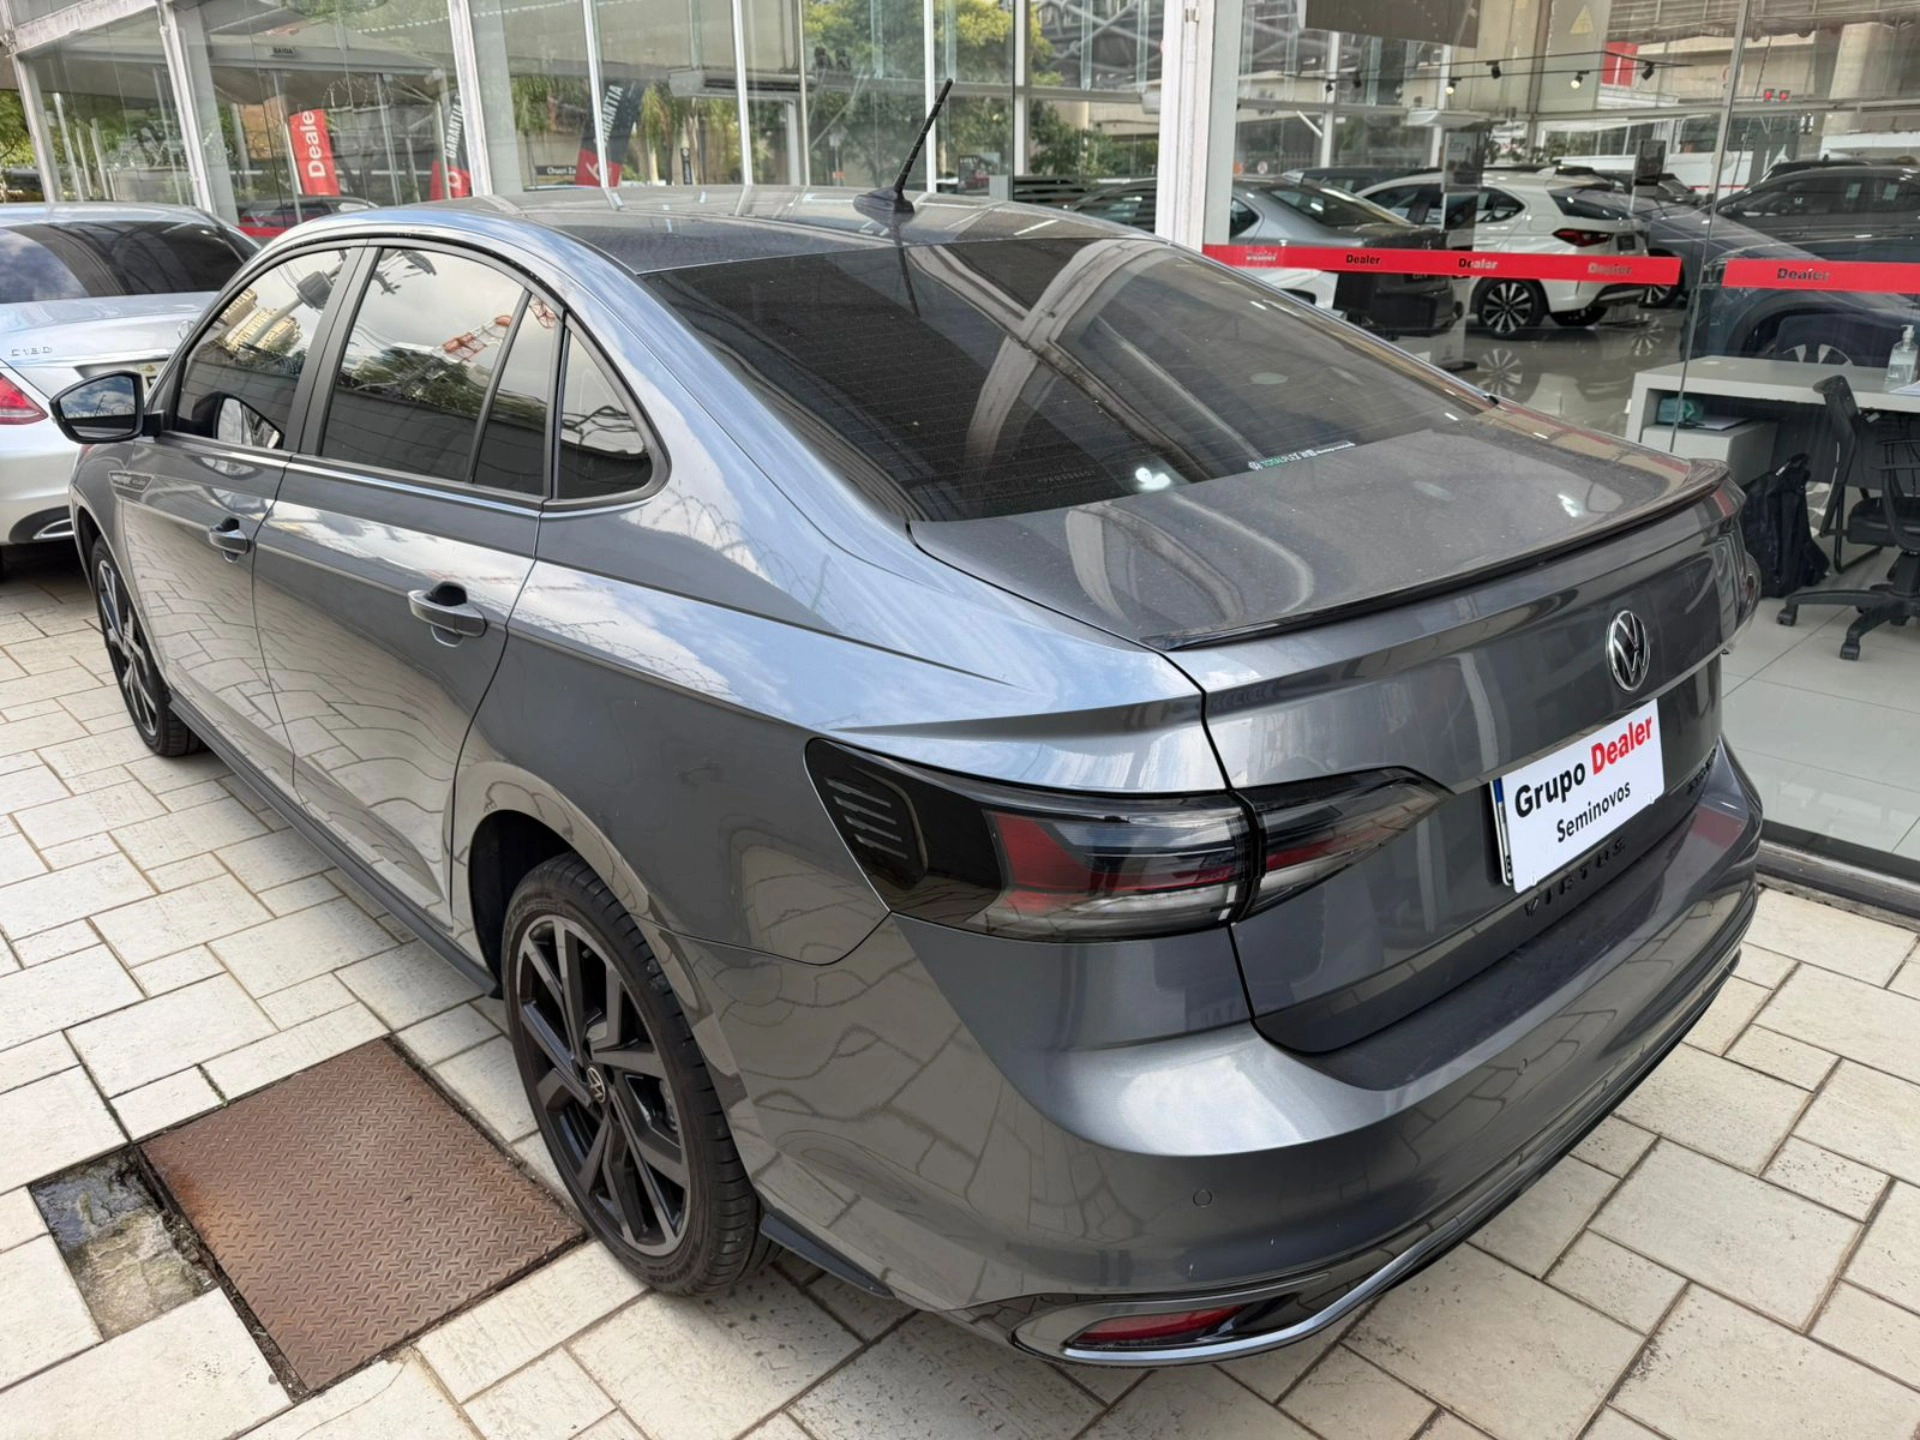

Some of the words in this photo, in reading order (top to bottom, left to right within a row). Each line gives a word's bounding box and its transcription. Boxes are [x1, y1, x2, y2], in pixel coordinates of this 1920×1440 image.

[596, 84, 623, 148] ARANTIA
[1346, 254, 1381, 265] Dealer
[1458, 257, 1498, 270] Dealer
[1777, 268, 1830, 281] Dealer
[1515, 763, 1586, 818] Grupo
[1591, 716, 1653, 775] Dealer
[1556, 782, 1631, 843] Seminovos
